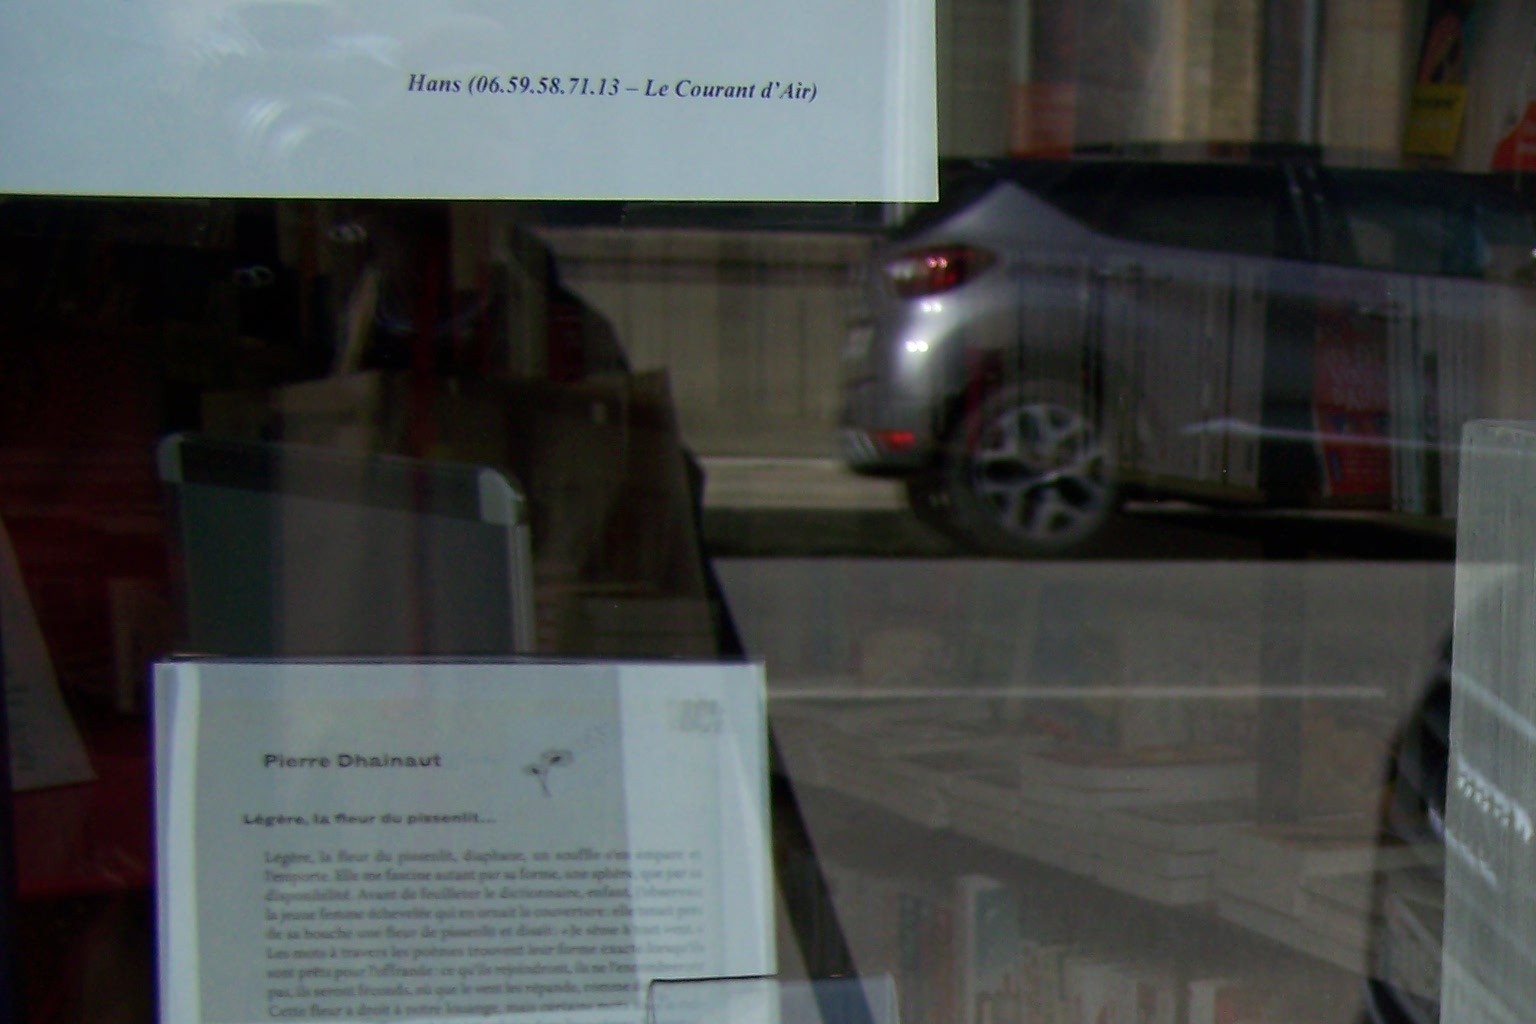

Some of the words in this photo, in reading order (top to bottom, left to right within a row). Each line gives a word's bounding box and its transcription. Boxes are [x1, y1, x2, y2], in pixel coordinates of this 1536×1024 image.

[408, 74, 461, 93] Hans
[468, 75, 620, 97] (06.59.58.71.13
[645, 80, 670, 97] Le
[675, 80, 756, 99] Courant
[263, 754, 331, 768] Pierre
[338, 753, 442, 768] Dhainaut
[314, 814, 330, 824] la
[336, 812, 375, 824] fleur
[381, 812, 400, 824] du
